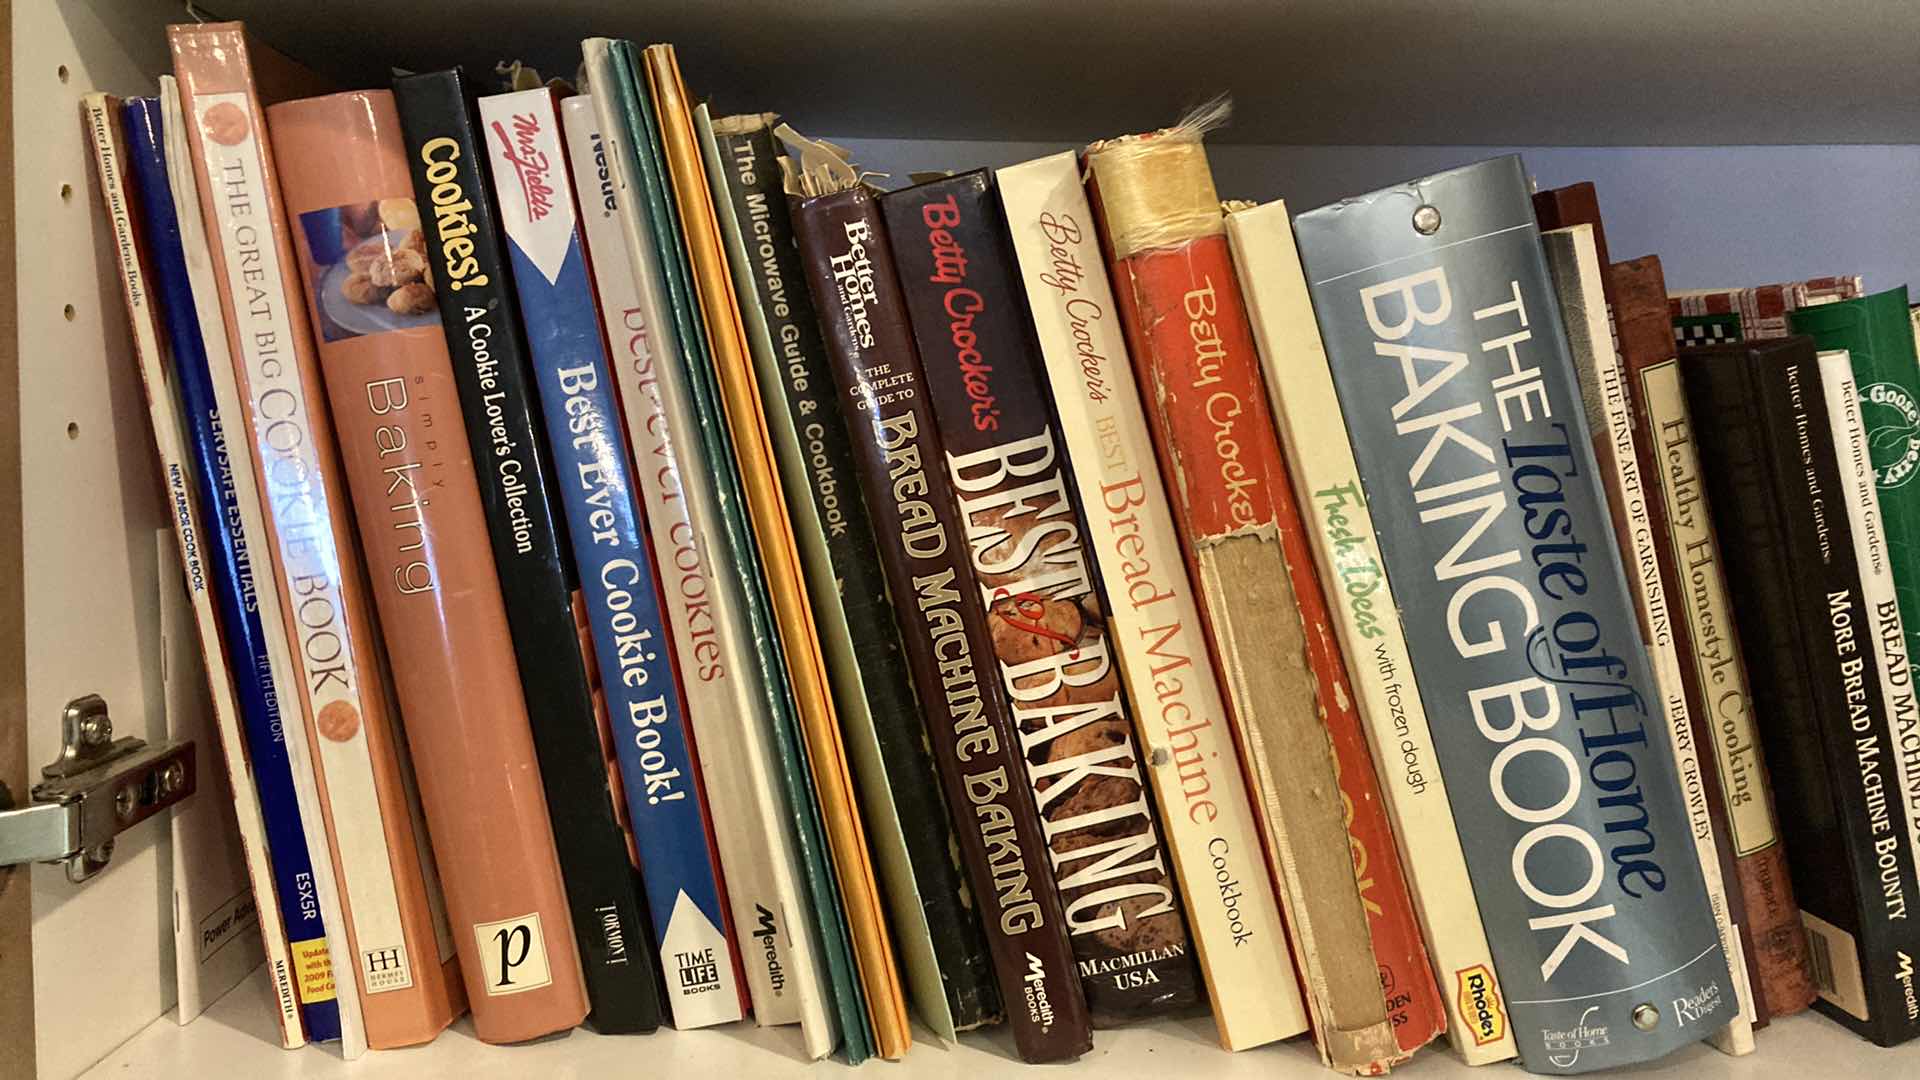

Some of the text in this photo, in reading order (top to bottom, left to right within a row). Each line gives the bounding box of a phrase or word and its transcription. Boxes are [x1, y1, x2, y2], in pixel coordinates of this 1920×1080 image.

[92, 108, 140, 307] Better Homes and Gardens Books
[421, 137, 489, 292] Cookies!
[829, 251, 875, 349] Homes
[837, 284, 849, 305] and
[844, 218, 879, 305] Better
[734, 140, 848, 538] The Microwave Guide & Cookbook
[922, 194, 999, 432] Betty Crocker's
[1183, 274, 1227, 388] Betty
[849, 372, 915, 397] COMPLETE
[857, 388, 914, 410] GUIDE TO
[865, 363, 891, 378] THE
[1602, 364, 1622, 407] THE
[224, 158, 349, 695] THE GREAT BIG COOKIE BOOK
[414, 376, 445, 489] simply
[463, 306, 533, 554] A Cookie Lover's Collection
[1611, 409, 1632, 455] FINE
[1786, 364, 1831, 559] Better Homes and Gardens
[366, 377, 434, 595] Baking
[945, 423, 1092, 613] BEST
[1314, 479, 1367, 557] Fresh
[1621, 458, 1640, 494] ART
[1630, 498, 1646, 525] OF
[1841, 380, 1882, 570] Better Homes and Gardens
[169, 463, 205, 591] NEW JUNIOR COOK BOOK
[227, 505, 259, 613] ESSENTIALS
[557, 362, 686, 806] Best Ever Cookie Book!
[1039, 211, 1253, 948] Betty Crocker's BEST Bread Machine Cookbook
[1472, 279, 1668, 899] THE Taste of Home
[1635, 526, 1671, 648] GARNISHING
[1662, 417, 1754, 807] Healthy Homestyle Cooking
[1359, 265, 1630, 983] BAKING BOOK
[1375, 643, 1396, 682] with
[1877, 600, 1909, 687] BREAD
[872, 409, 1044, 936] BREAD MACHINE BAKING
[1384, 682, 1409, 738] frozen
[264, 690, 284, 743] EDITION
[1826, 589, 1907, 920] MORE BREAD MACHINE BOUNTY
[999, 634, 1176, 936] BAKING
[1401, 740, 1427, 795] dough
[1669, 695, 1710, 841] JERRY CROWLEY
[204, 915, 232, 948] Power
[295, 872, 317, 921] ESX5R
[275, 959, 293, 1014] MEREDITH
[674, 948, 715, 968] TIME
[680, 965, 717, 986] LIFE
[683, 984, 721, 995] BOOKS
[752, 903, 785, 990] Meredith
[1024, 952, 1054, 1025] Meredith
[1114, 968, 1160, 991] USA
[1895, 951, 1920, 1020] Meredith
[1023, 986, 1041, 1023] BOOKS
[1468, 974, 1494, 1037] Rhodes
[1541, 1025, 1608, 1041] Taste of Home
